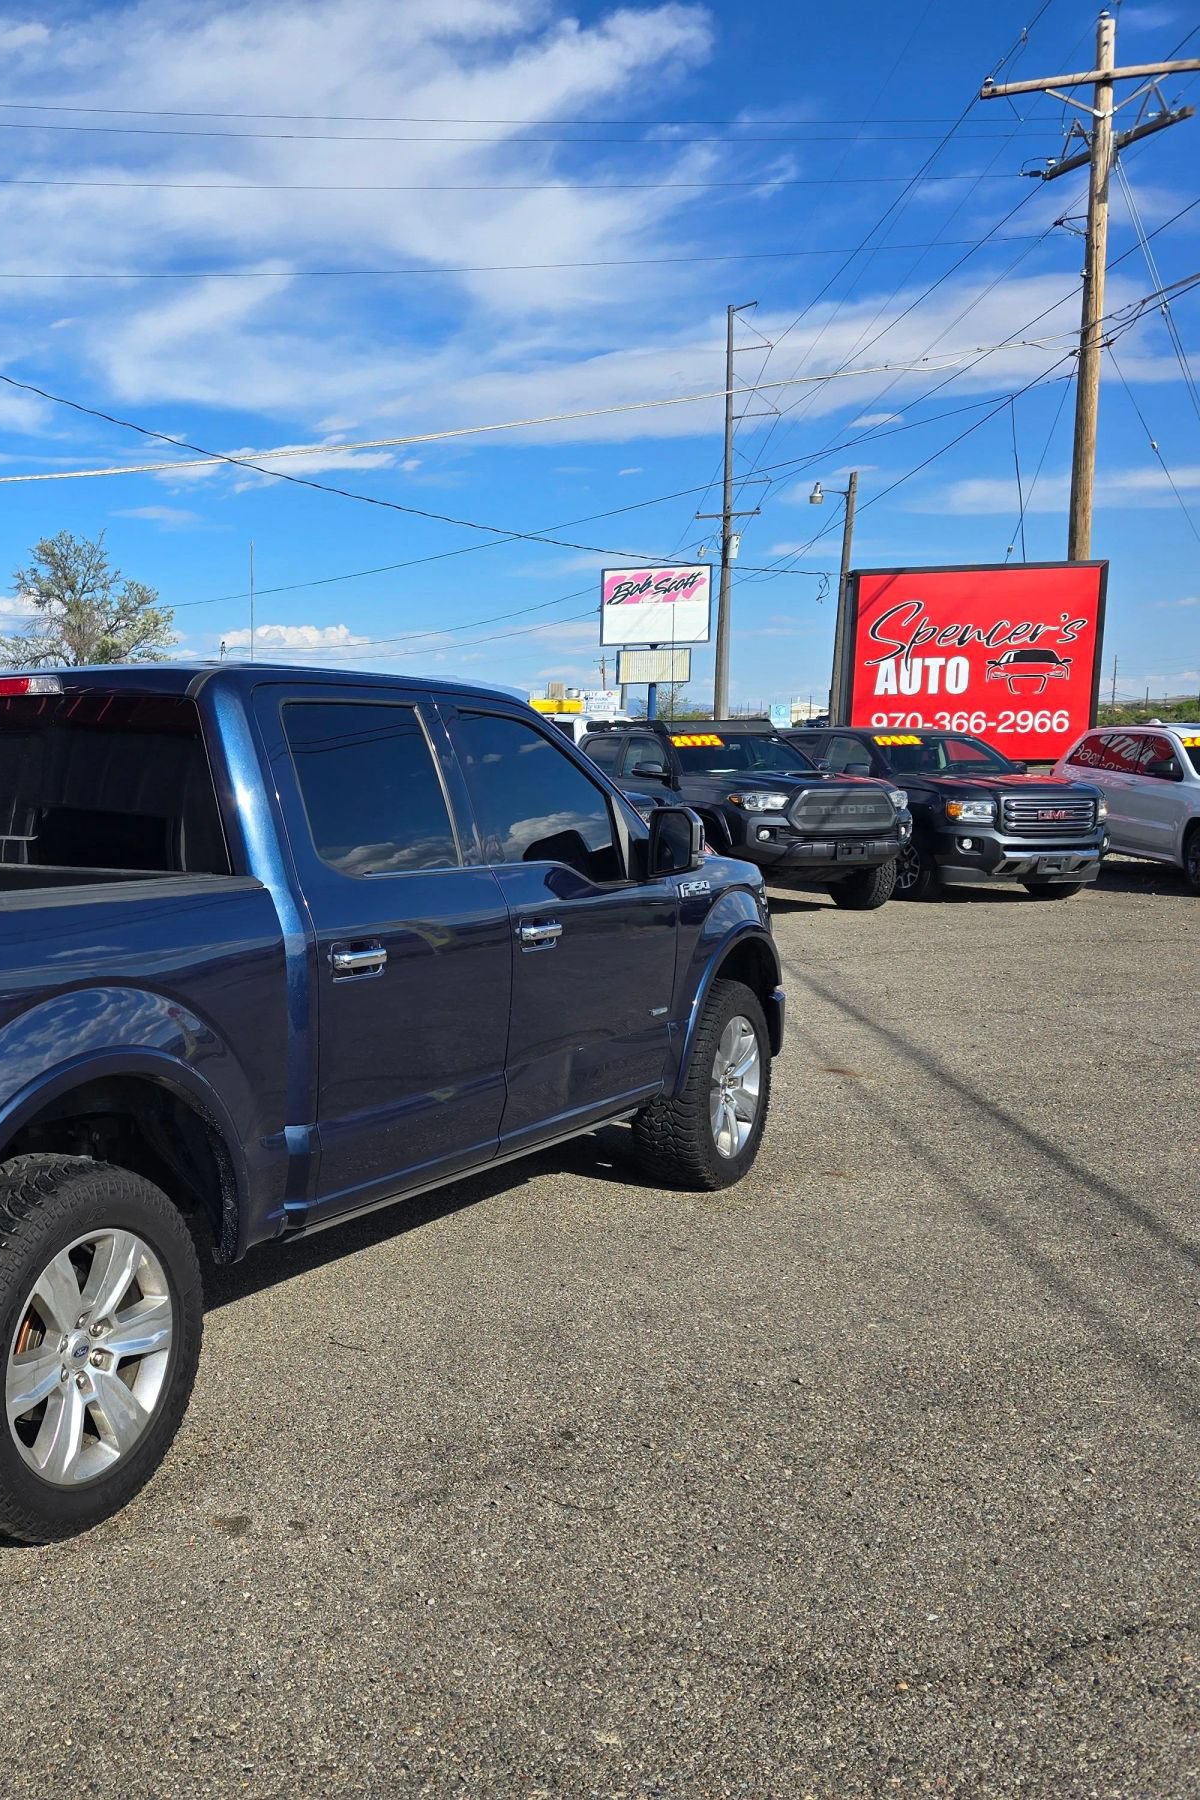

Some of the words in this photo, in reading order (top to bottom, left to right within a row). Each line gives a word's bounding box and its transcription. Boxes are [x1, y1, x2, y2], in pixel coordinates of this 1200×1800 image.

[607, 575, 653, 605] Bob
[651, 571, 703, 596] Scott
[864, 600, 1087, 672] Spencer's
[874, 656, 969, 695] AUTO
[871, 710, 1069, 733] 970-366-2966
[819, 806, 876, 814] TOYOTA
[1038, 810, 1074, 820] GMC
